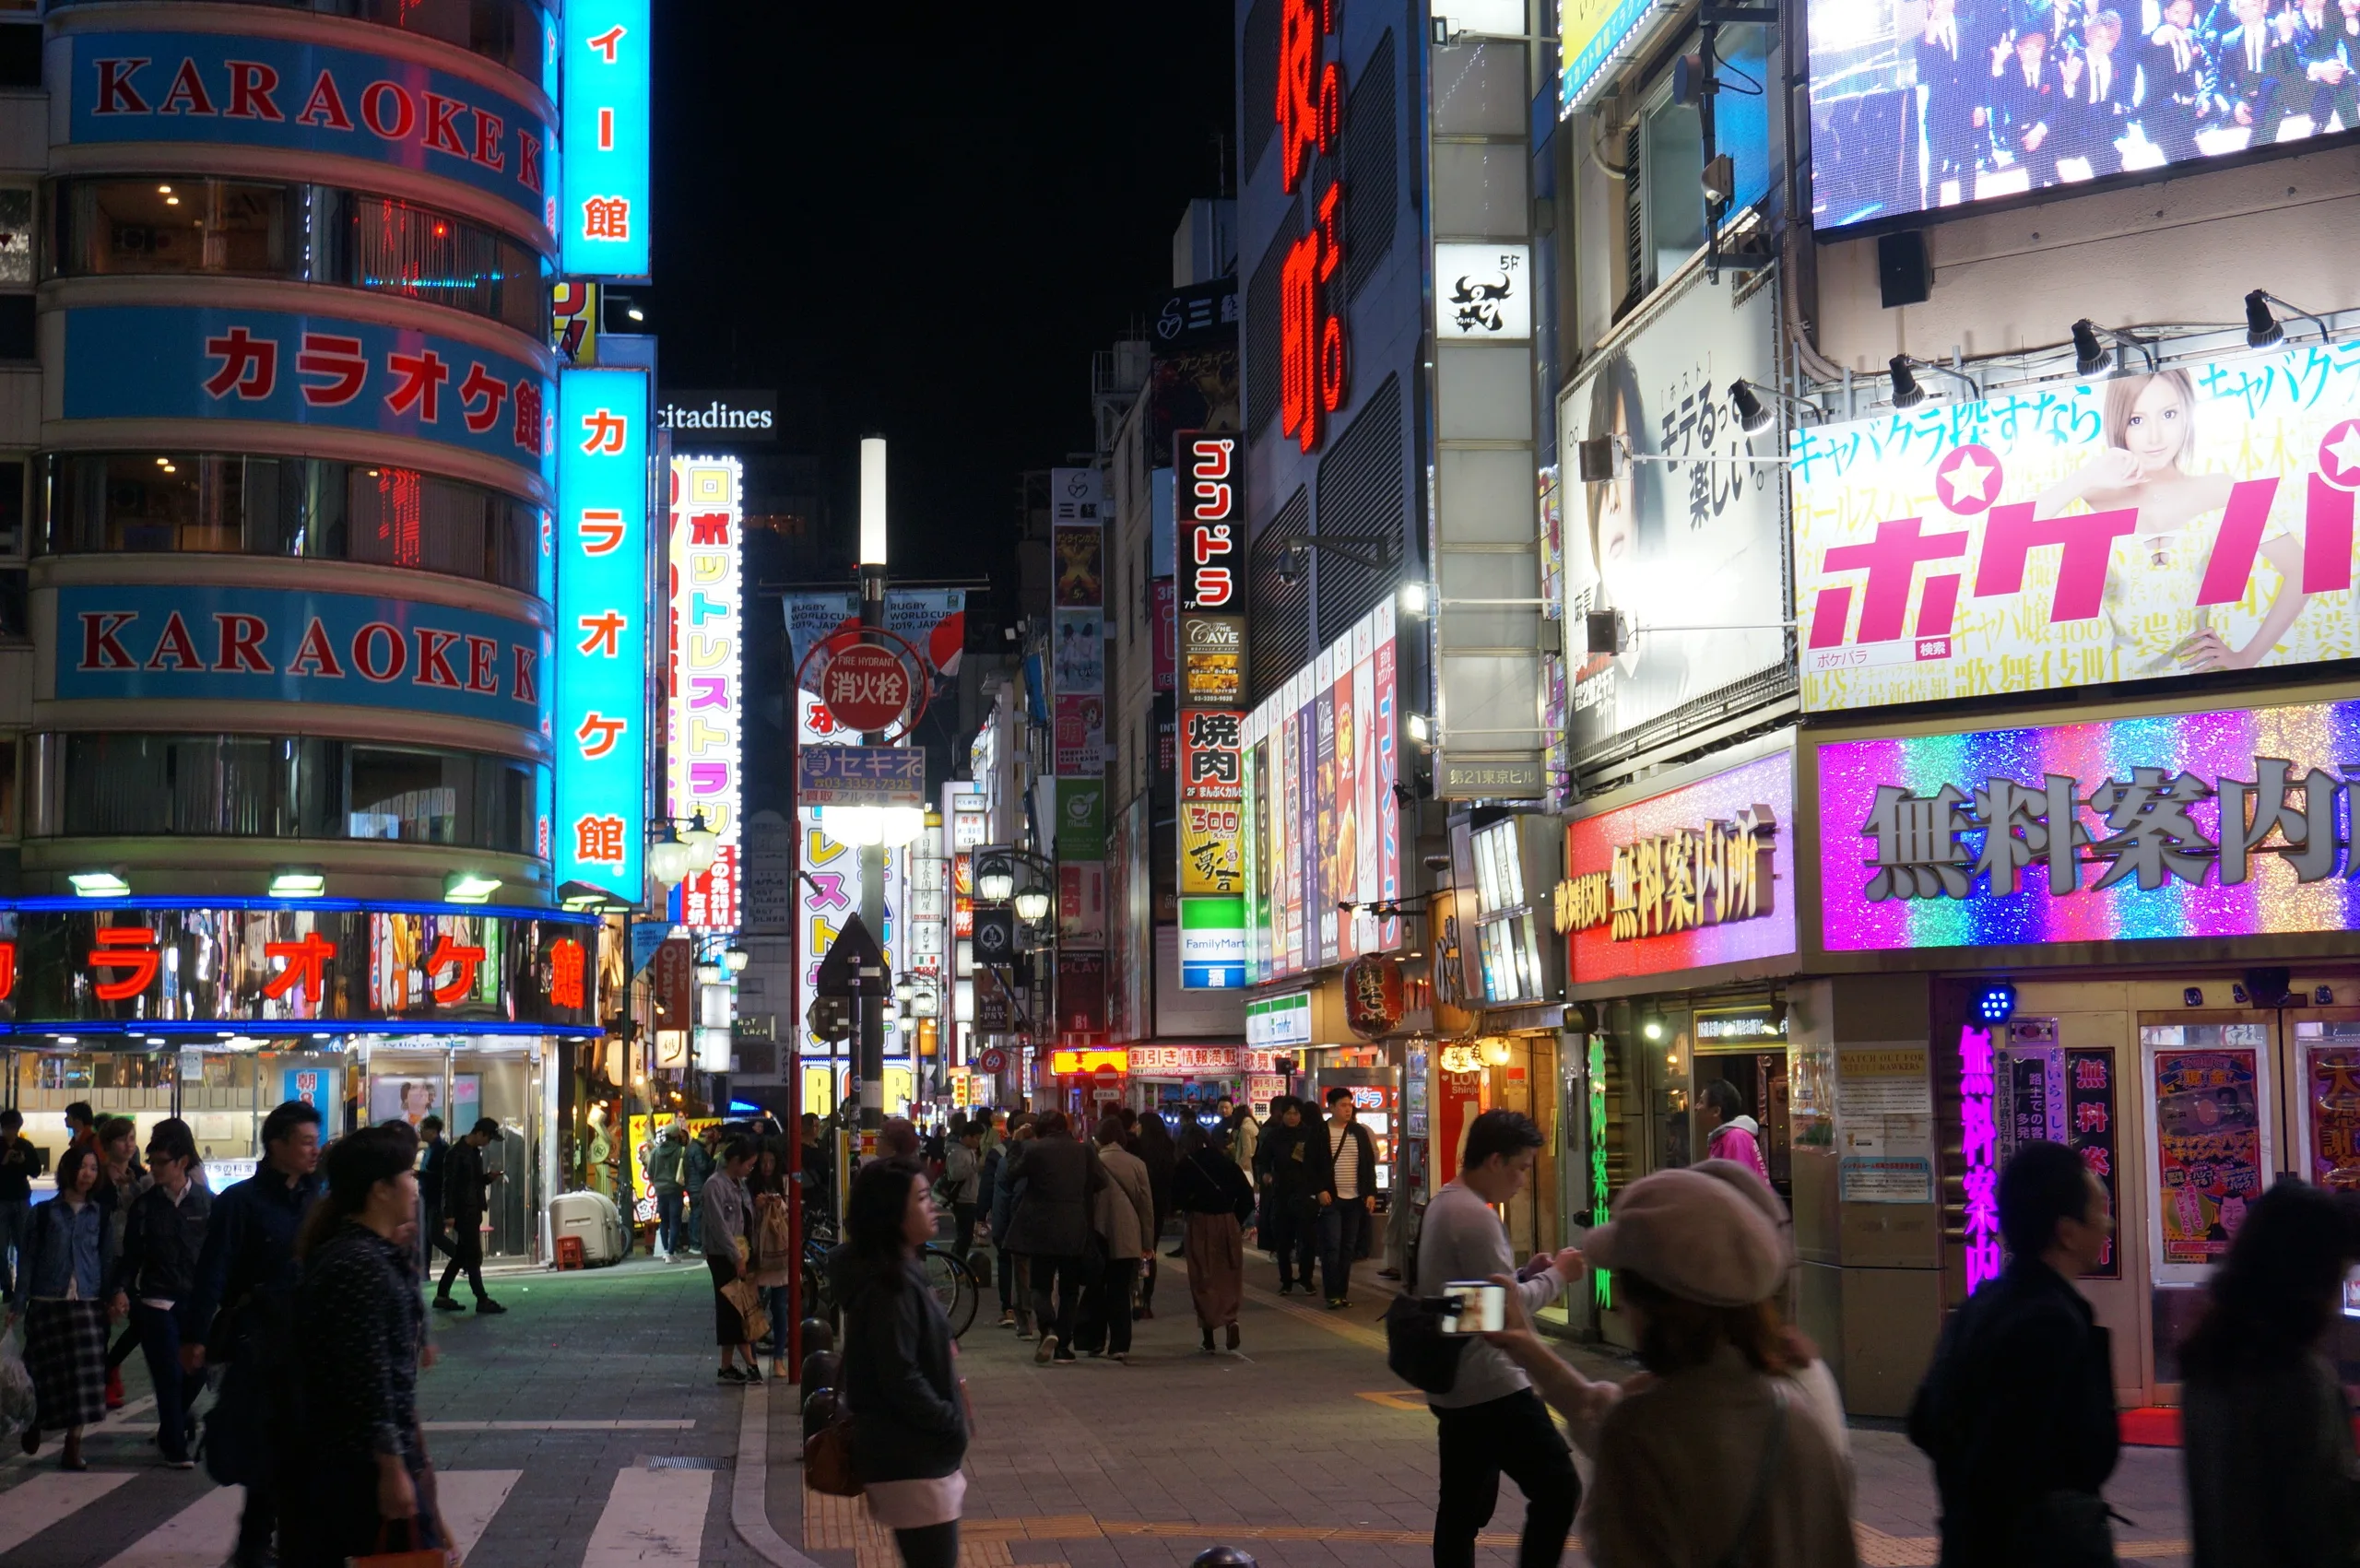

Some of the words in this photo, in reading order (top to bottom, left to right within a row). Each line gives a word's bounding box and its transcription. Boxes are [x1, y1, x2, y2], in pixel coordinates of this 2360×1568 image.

[92, 58, 504, 172] KARAOKE
[1499, 253, 1520, 270] 5F
[202, 325, 542, 458] カラオケ館
[657, 401, 773, 429] citadines
[1790, 384, 2103, 484] キャバクラ探すなら
[1193, 438, 1234, 607] ゴンドラ
[791, 604, 827, 613] RUGBY
[890, 602, 927, 611] RUGBY
[891, 610, 928, 621] WORLD
[930, 610, 952, 620] CUP
[791, 612, 828, 621] WORLD
[891, 621, 914, 631] 2019,
[576, 407, 631, 865] カラオケ館
[77, 610, 499, 696] KARAOKE
[1918, 640, 1947, 657] 検索
[838, 656, 856, 666] FIRE
[858, 656, 895, 667] HYDRANT
[1816, 648, 1868, 669] ポケパラ
[831, 671, 903, 705] 消火栓
[1187, 713, 1241, 784] 焼肉
[834, 749, 923, 778] セキネ
[1450, 769, 1535, 784] 第21東京ビル
[1191, 808, 1239, 834] 300
[1860, 755, 2360, 902] 無料案内
[1611, 806, 1762, 942] 無料案内所
[1186, 937, 1246, 950] FamilyMart
[1059, 961, 1103, 973] PLAY
[1208, 968, 1226, 987] 酒
[1075, 1014, 1088, 1030] B1
[1130, 1048, 1178, 1067] 割引き
[1904, 1053, 1925, 1061] FOR
[1880, 1062, 1920, 1071] HAWKERS
[1451, 1073, 1481, 1085] LOV
[1452, 1086, 1480, 1095] Shinju
